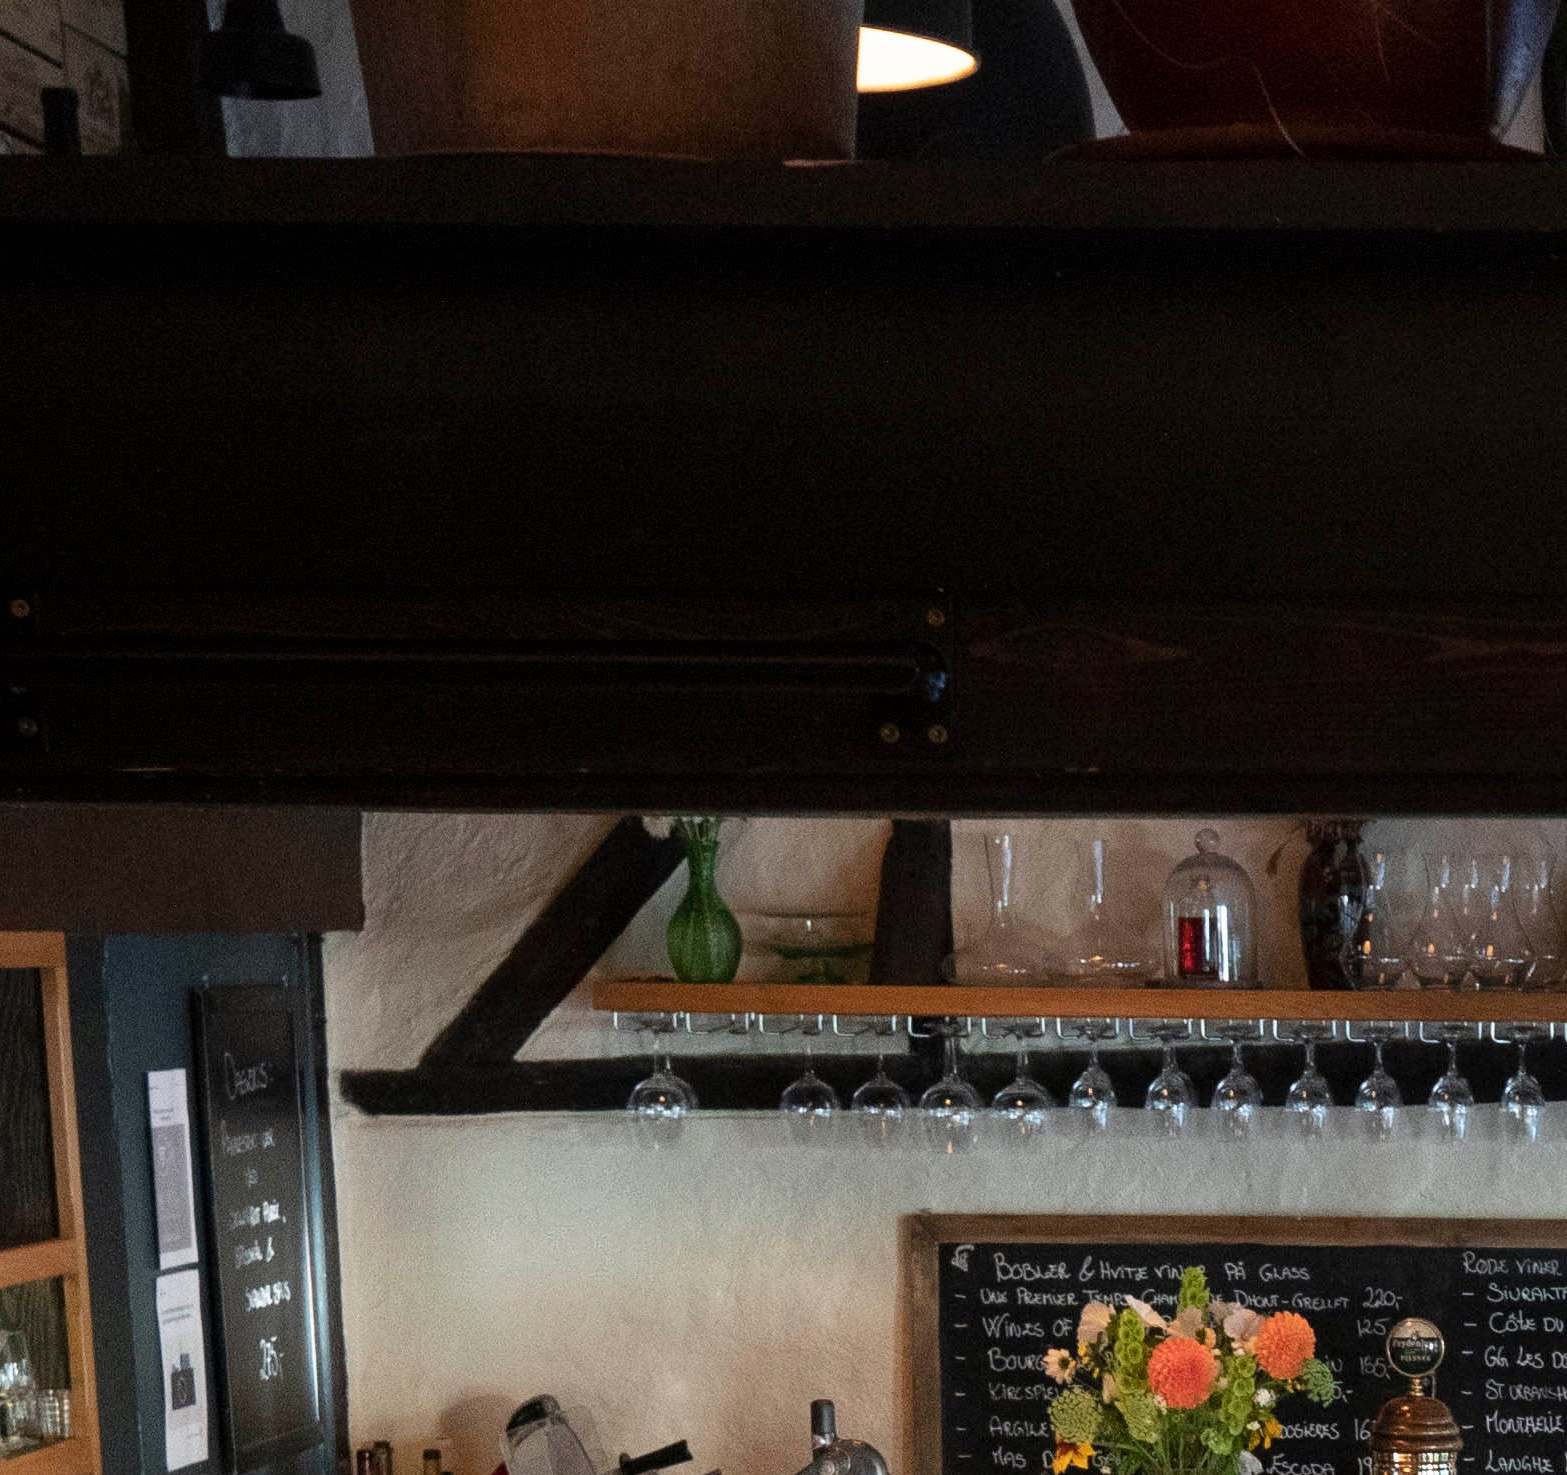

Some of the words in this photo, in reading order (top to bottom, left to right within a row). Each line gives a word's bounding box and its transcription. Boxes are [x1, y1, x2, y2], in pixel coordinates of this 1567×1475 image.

[994, 1252, 1072, 1282] BOBLER
[1079, 1256, 1095, 1281] &
[1100, 1259, 1148, 1280] HVITE
[1224, 1262, 1246, 1280] PÅ
[1258, 1264, 1311, 1282] GLASS
[1516, 1258, 1563, 1277] VINER
[1016, 1287, 1078, 1305] PREMIER
[1362, 1286, 1403, 1310] 220,-
[983, 1313, 1045, 1339] WINES
[1052, 1318, 1073, 1337] OF
[1489, 1310, 1536, 1333] CÔTE
[1543, 1317, 1564, 1333] DU
[1517, 1346, 1544, 1369] LES
[1354, 1418, 1372, 1440] 16
[992, 1446, 1027, 1468] MAS
[1485, 1449, 1554, 1473] LANGHE
